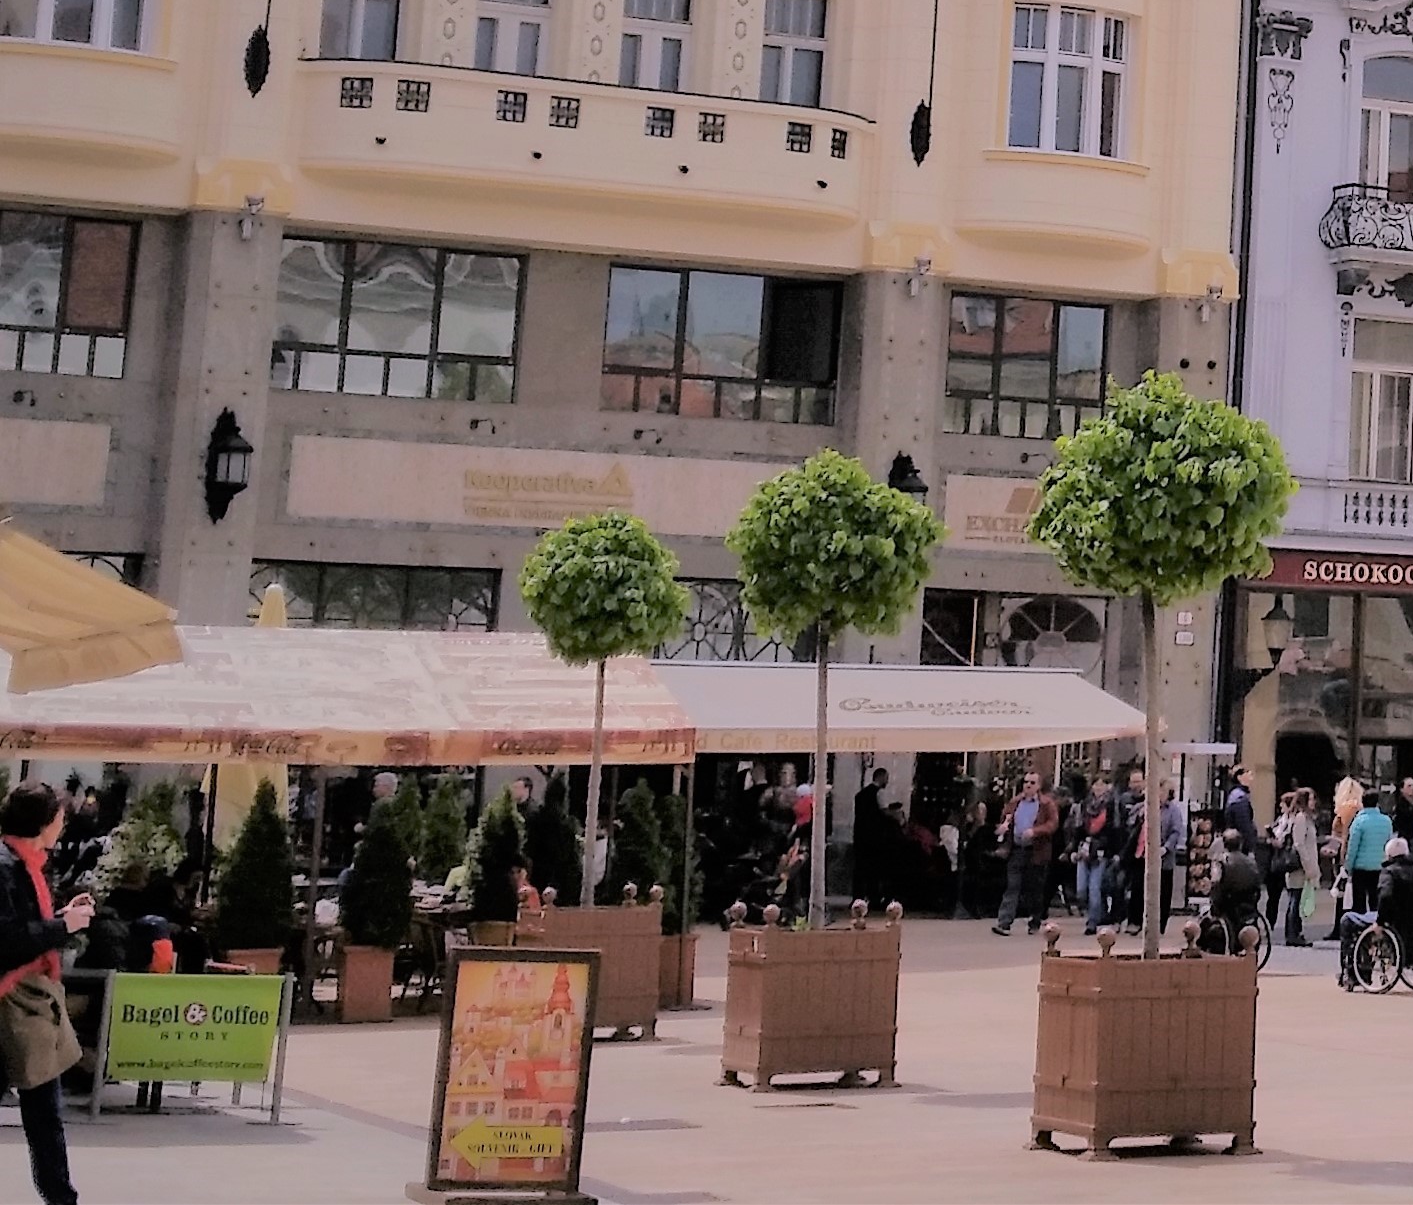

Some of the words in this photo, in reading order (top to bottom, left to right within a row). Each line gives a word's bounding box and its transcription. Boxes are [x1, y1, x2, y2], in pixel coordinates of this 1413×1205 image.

[464, 469, 598, 495] Kooperativa
[720, 733, 762, 749] Cafe
[122, 1003, 179, 1027] Bagel
[186, 1003, 208, 1025] &
[212, 1005, 270, 1026] Coffee
[160, 1031, 229, 1041] STORY
